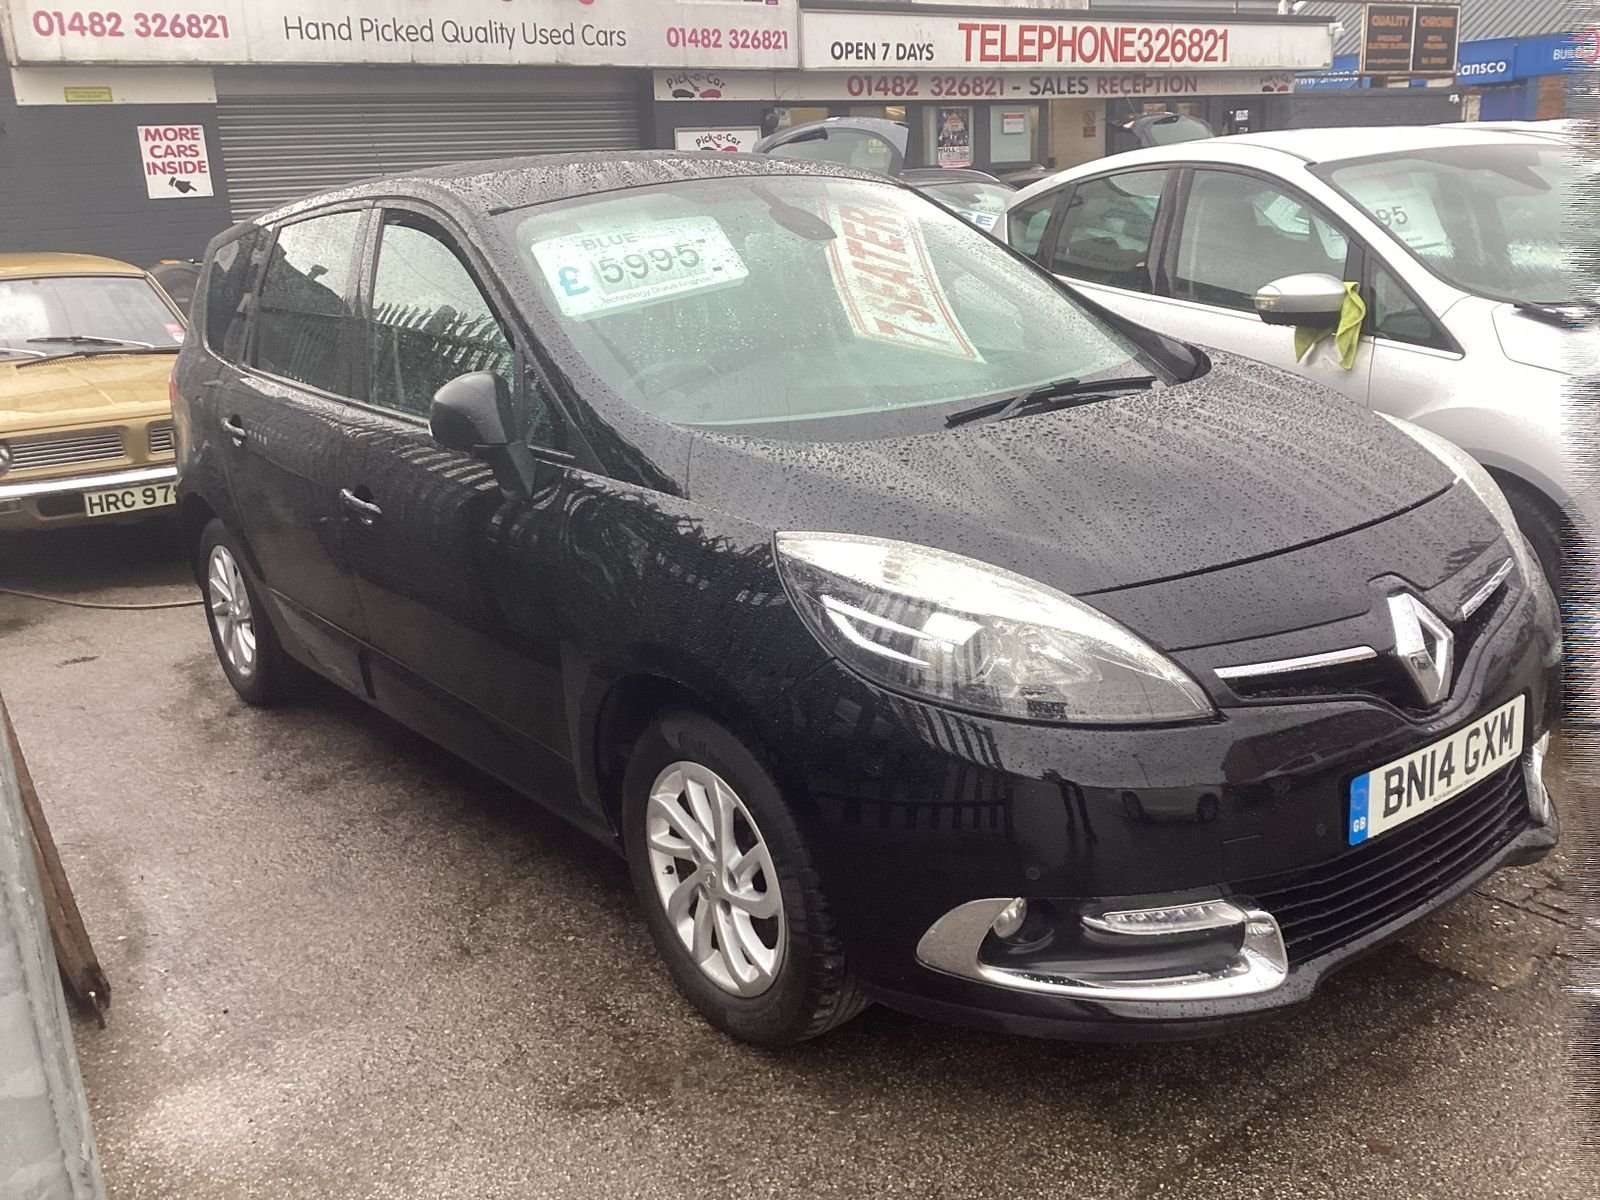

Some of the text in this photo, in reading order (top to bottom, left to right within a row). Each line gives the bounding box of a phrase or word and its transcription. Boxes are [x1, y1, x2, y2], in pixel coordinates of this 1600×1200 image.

[33, 10, 229, 39] 01482 326821
[284, 16, 627, 50] Hand Picked Quality Used Cars
[666, 27, 789, 50] 01482 326821
[830, 41, 935, 61] OPEN 7 DAYS
[847, 75, 919, 97] 01482
[930, 75, 1005, 97] 326821
[1029, 76, 1089, 96] SALES
[1096, 75, 1198, 95] RECEPTION
[144, 127, 201, 142] MORE
[149, 144, 200, 158] CARS
[146, 161, 208, 175] INSIDE
[581, 232, 641, 252] BLUE
[558, 243, 700, 297] £ 5995
[87, 484, 177, 515] HRC 97
[1383, 741, 1456, 819] BN14
[1464, 706, 1515, 776] GXM
[1353, 816, 1367, 832] GB
